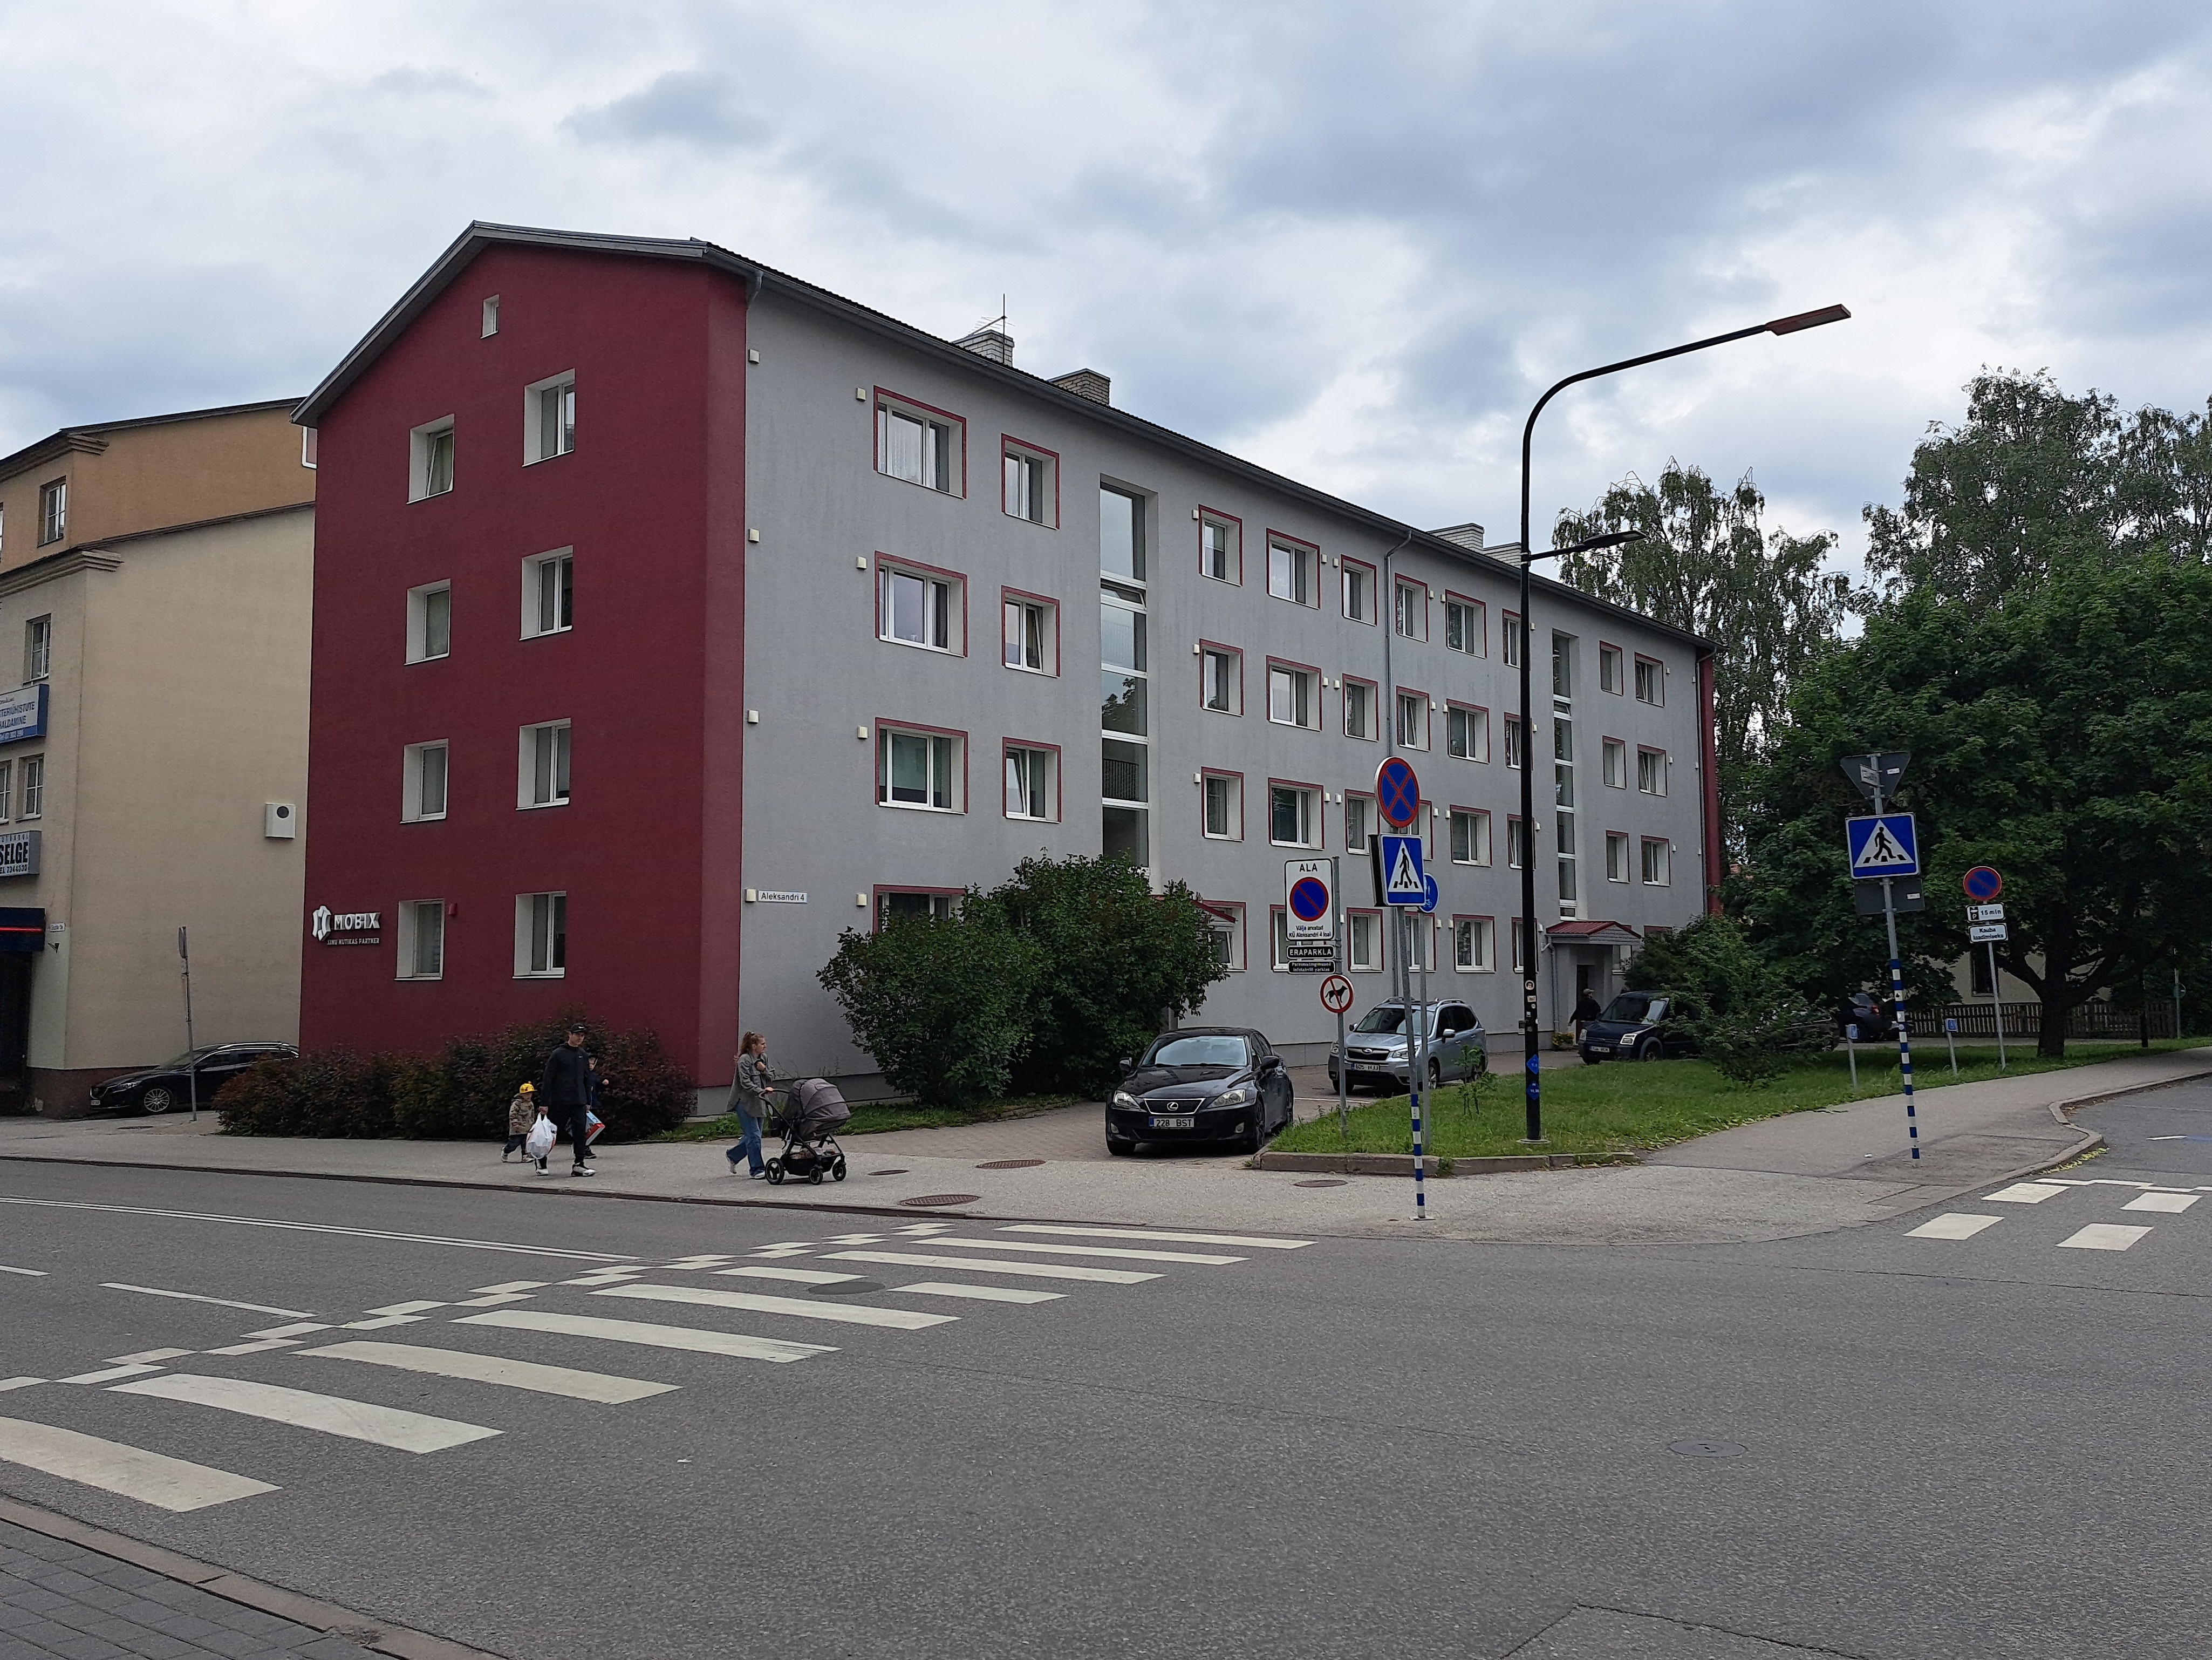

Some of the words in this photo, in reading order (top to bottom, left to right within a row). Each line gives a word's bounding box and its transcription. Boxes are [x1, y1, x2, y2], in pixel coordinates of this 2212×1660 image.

[0, 701, 35, 718] TERIÜHISTUTE
[0, 841, 29, 866] SELGE
[1300, 863, 1317, 872] ALA
[761, 892, 799, 901] Aleksandri
[334, 911, 380, 930] MOBIX
[1176, 1119, 1192, 1127] BST
